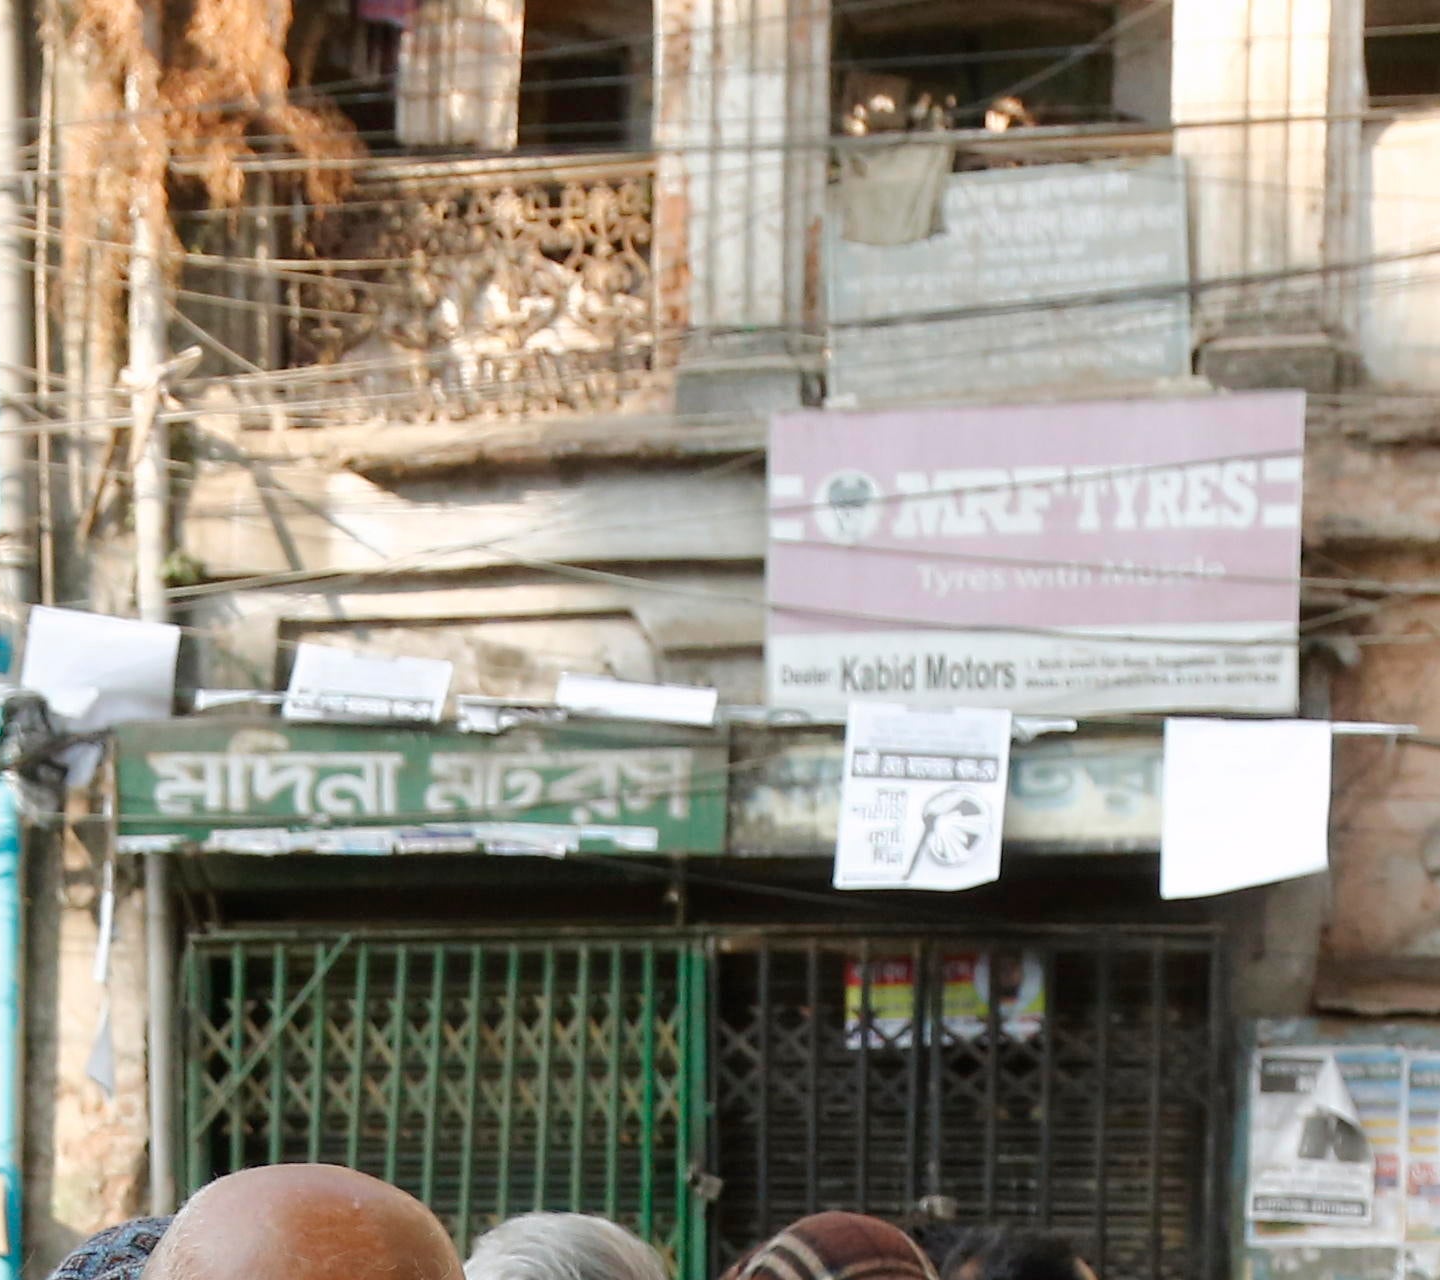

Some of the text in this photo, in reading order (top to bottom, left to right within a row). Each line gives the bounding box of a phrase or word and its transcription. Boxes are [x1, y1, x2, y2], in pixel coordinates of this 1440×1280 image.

[892, 460, 1259, 537] MRF TYRES
[917, 563, 1005, 599] Tyres
[1014, 560, 1092, 590] with
[839, 653, 918, 694] Kabid
[925, 654, 1017, 691] Motors
[147, 729, 405, 816] মদিনা
